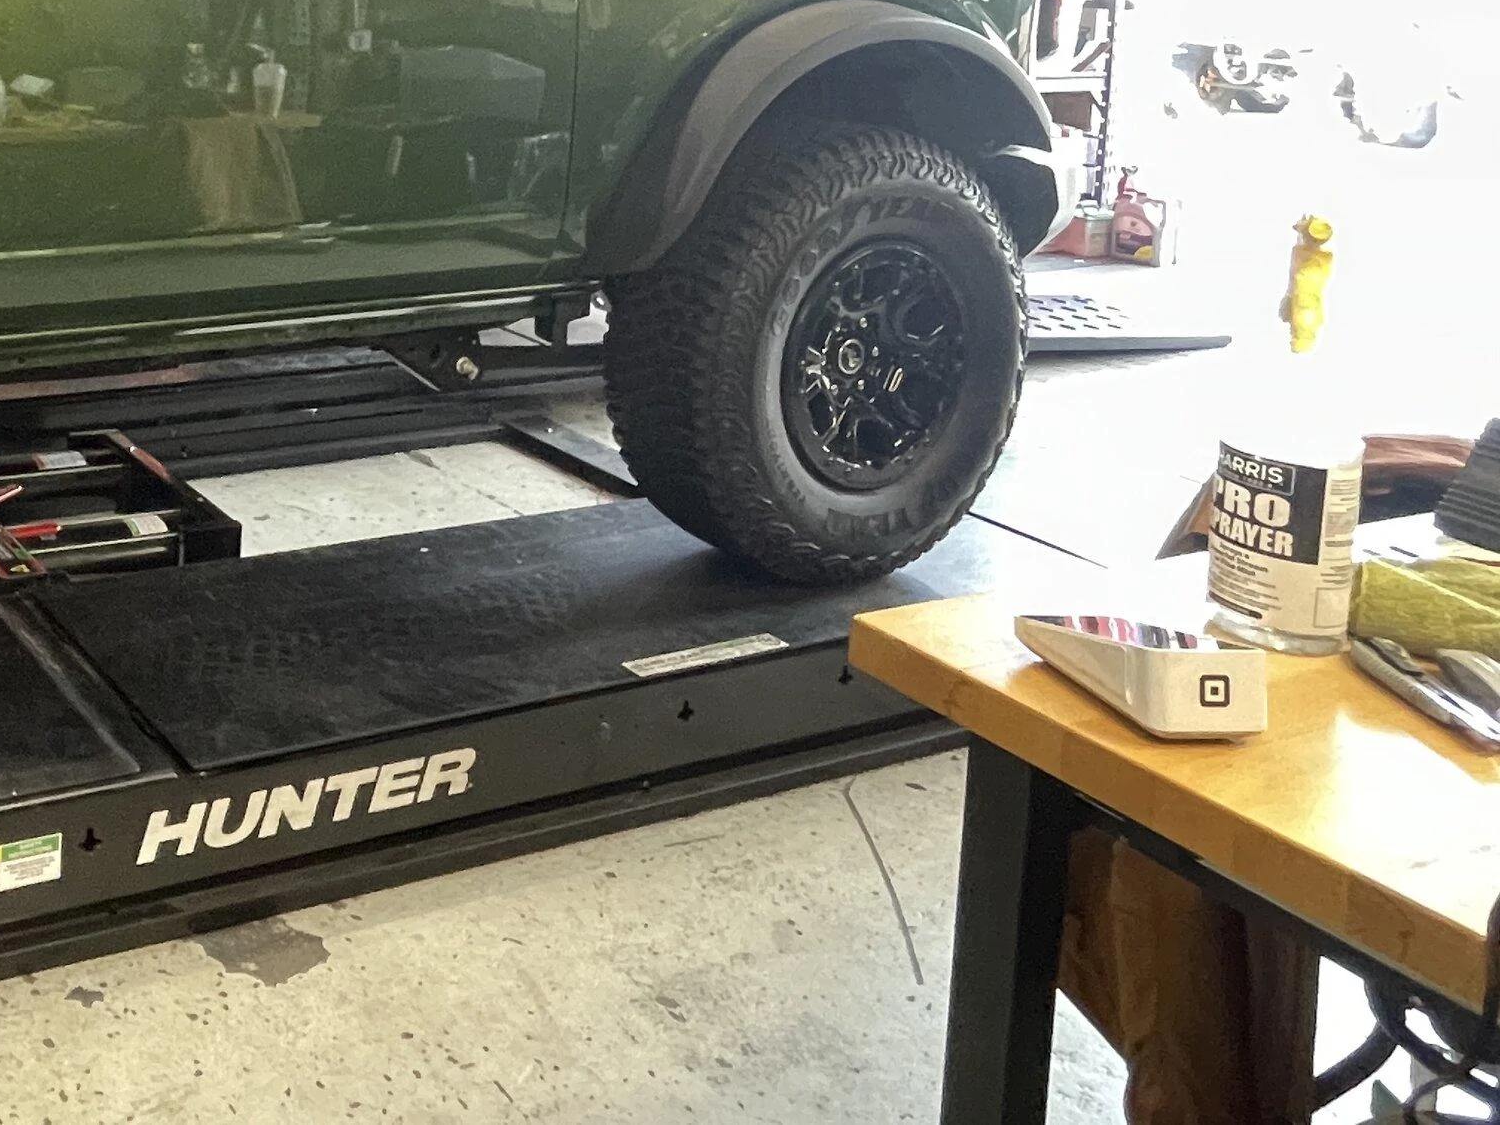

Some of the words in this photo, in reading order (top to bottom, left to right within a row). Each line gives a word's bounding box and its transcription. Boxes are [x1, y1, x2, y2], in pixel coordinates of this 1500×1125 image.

[1220, 451, 1285, 485] ARRIS
[1211, 508, 1294, 557] PRAYER
[136, 748, 476, 866] HUNTER
